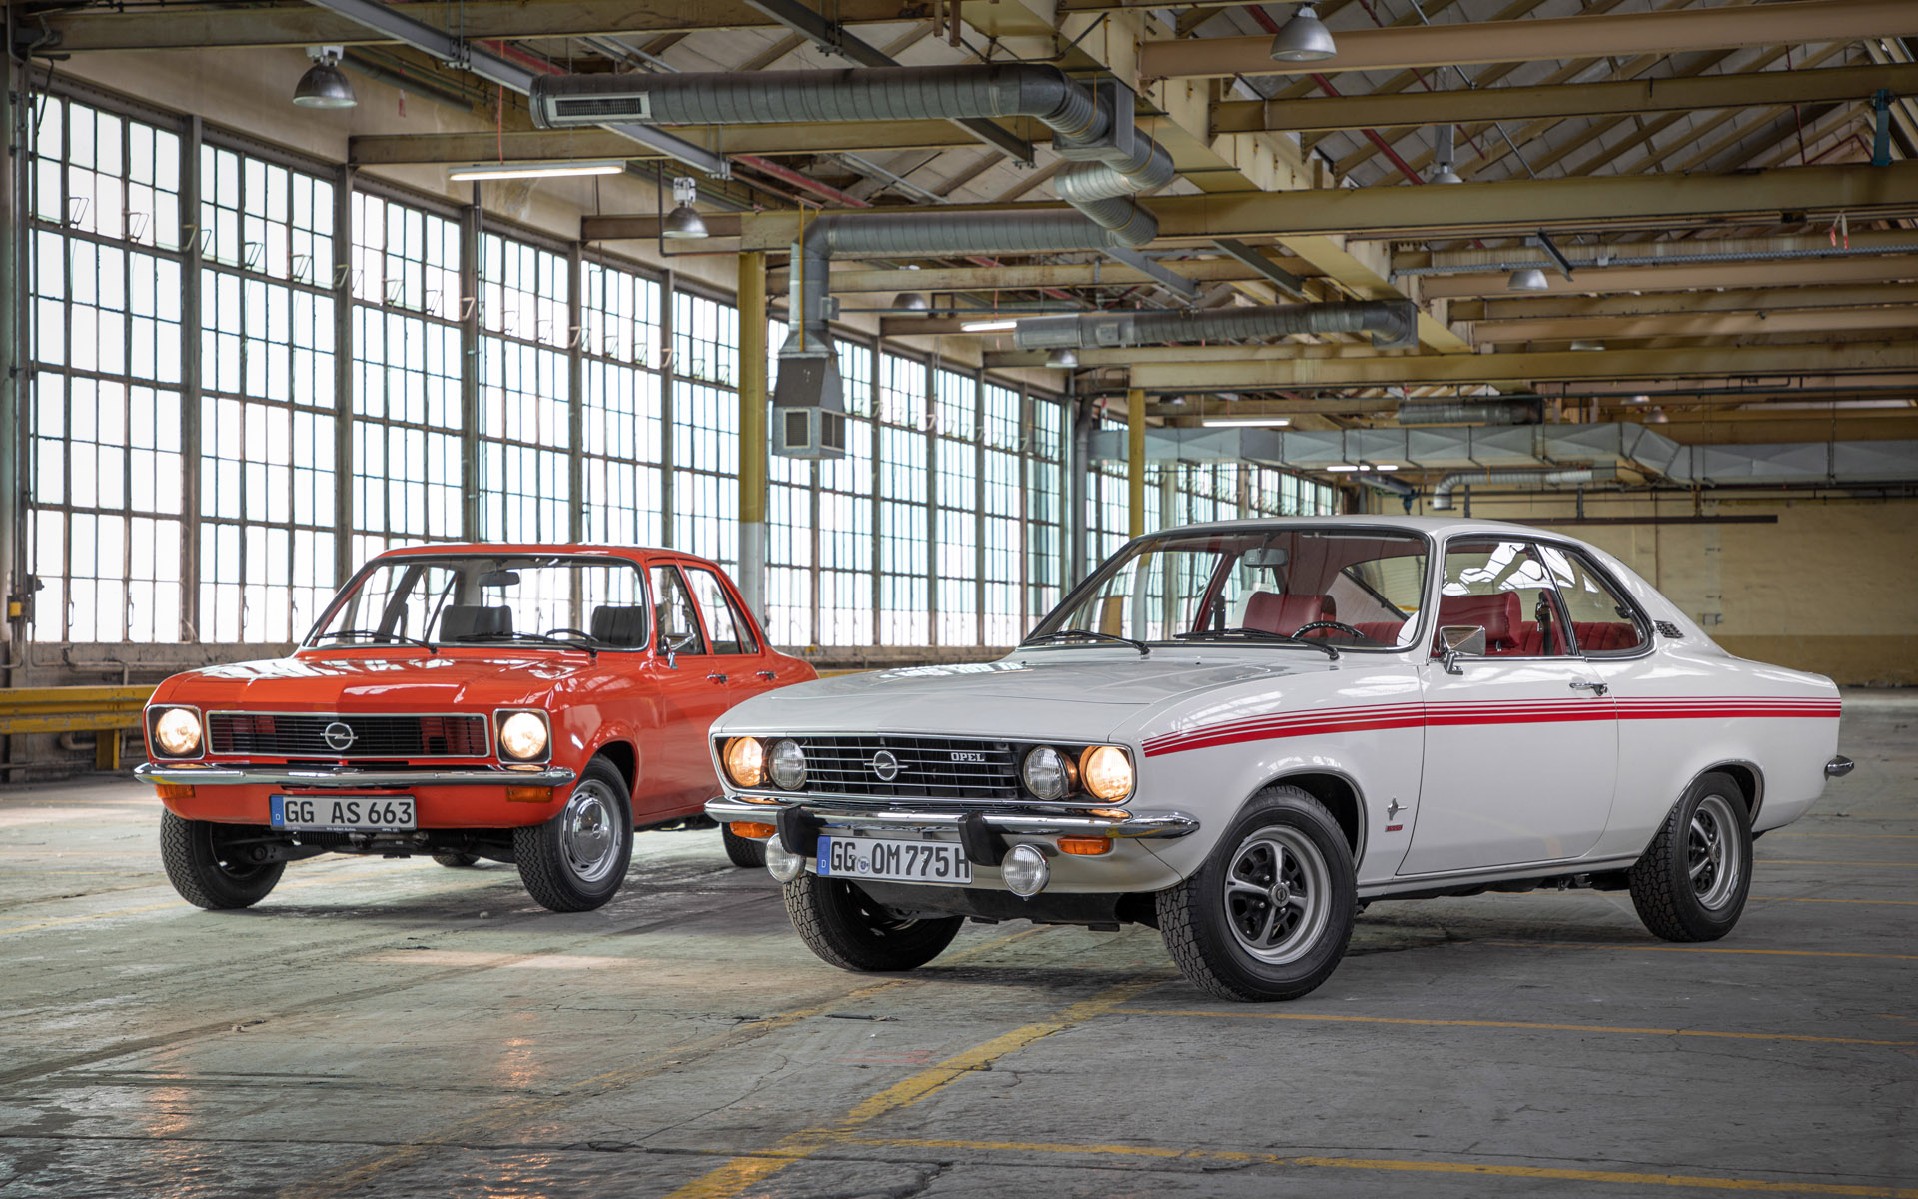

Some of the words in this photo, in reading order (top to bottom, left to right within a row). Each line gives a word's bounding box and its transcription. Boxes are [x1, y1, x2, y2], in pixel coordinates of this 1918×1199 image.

[950, 752, 985, 762] OPEL
[284, 800, 315, 823] GG
[331, 801, 361, 824] AS
[368, 801, 412, 825] 663
[830, 841, 856, 872] GG
[871, 842, 900, 875] OM
